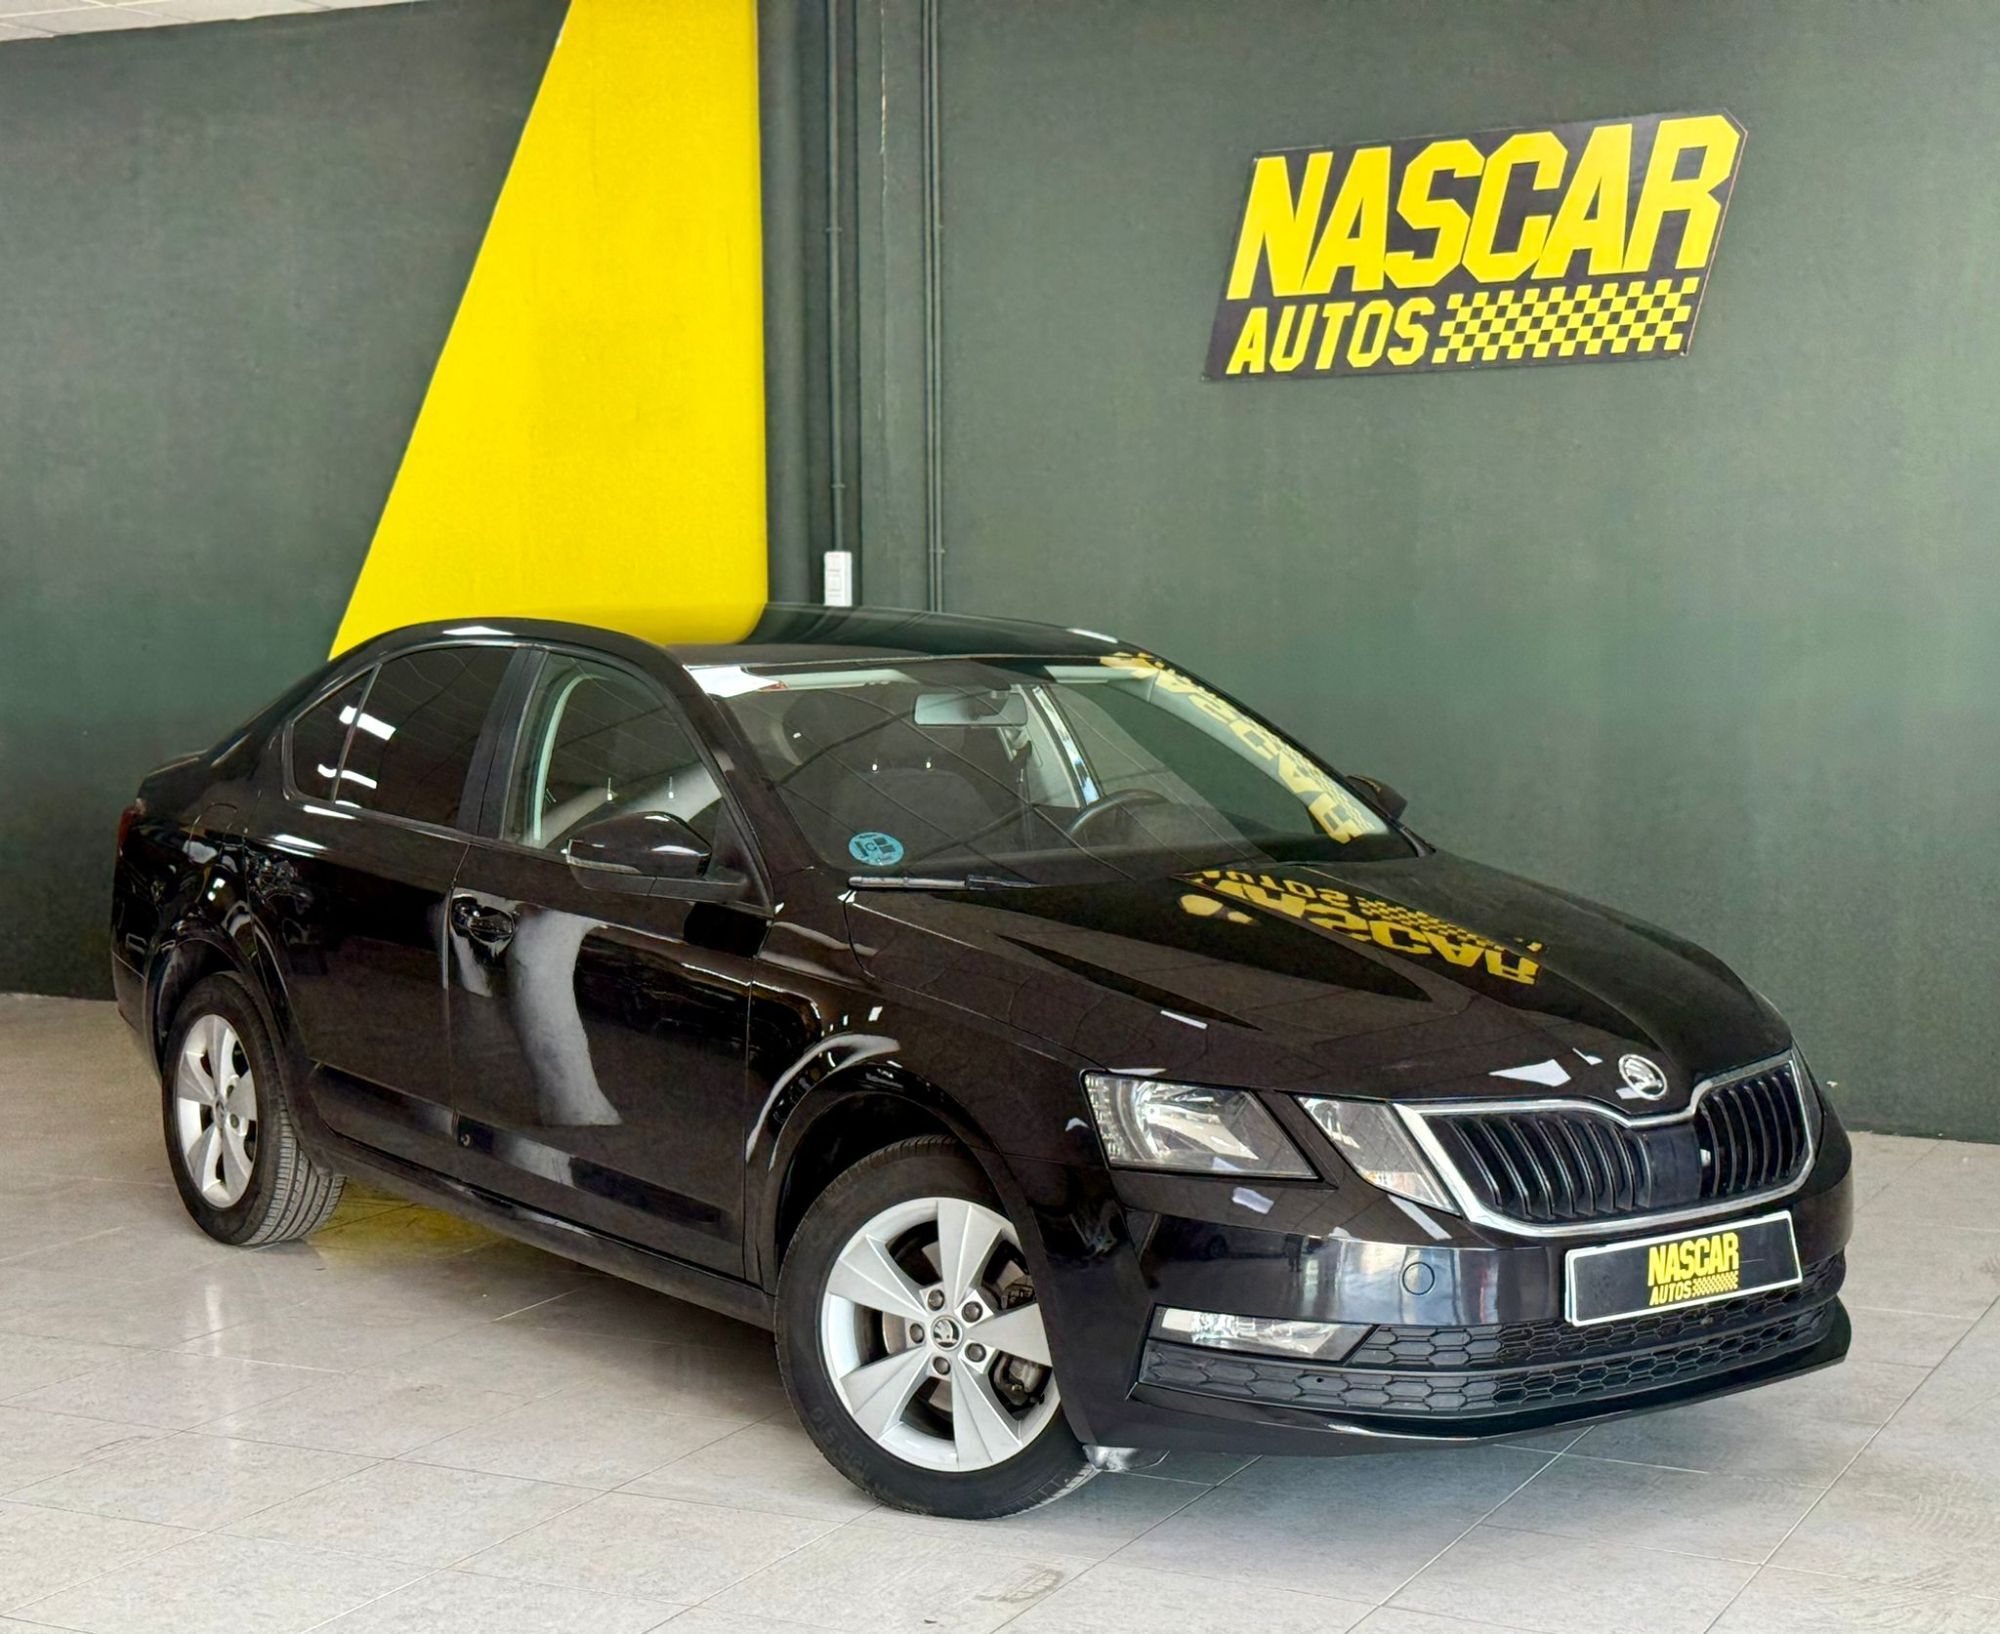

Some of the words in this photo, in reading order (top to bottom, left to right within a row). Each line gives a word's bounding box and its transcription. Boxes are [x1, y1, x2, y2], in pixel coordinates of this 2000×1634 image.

[1226, 115, 1740, 299] NASCAR
[1226, 297, 1435, 375] AUTOS
[1648, 1232, 1740, 1286] NASCAR
[1649, 1281, 1692, 1306] AUTOS
